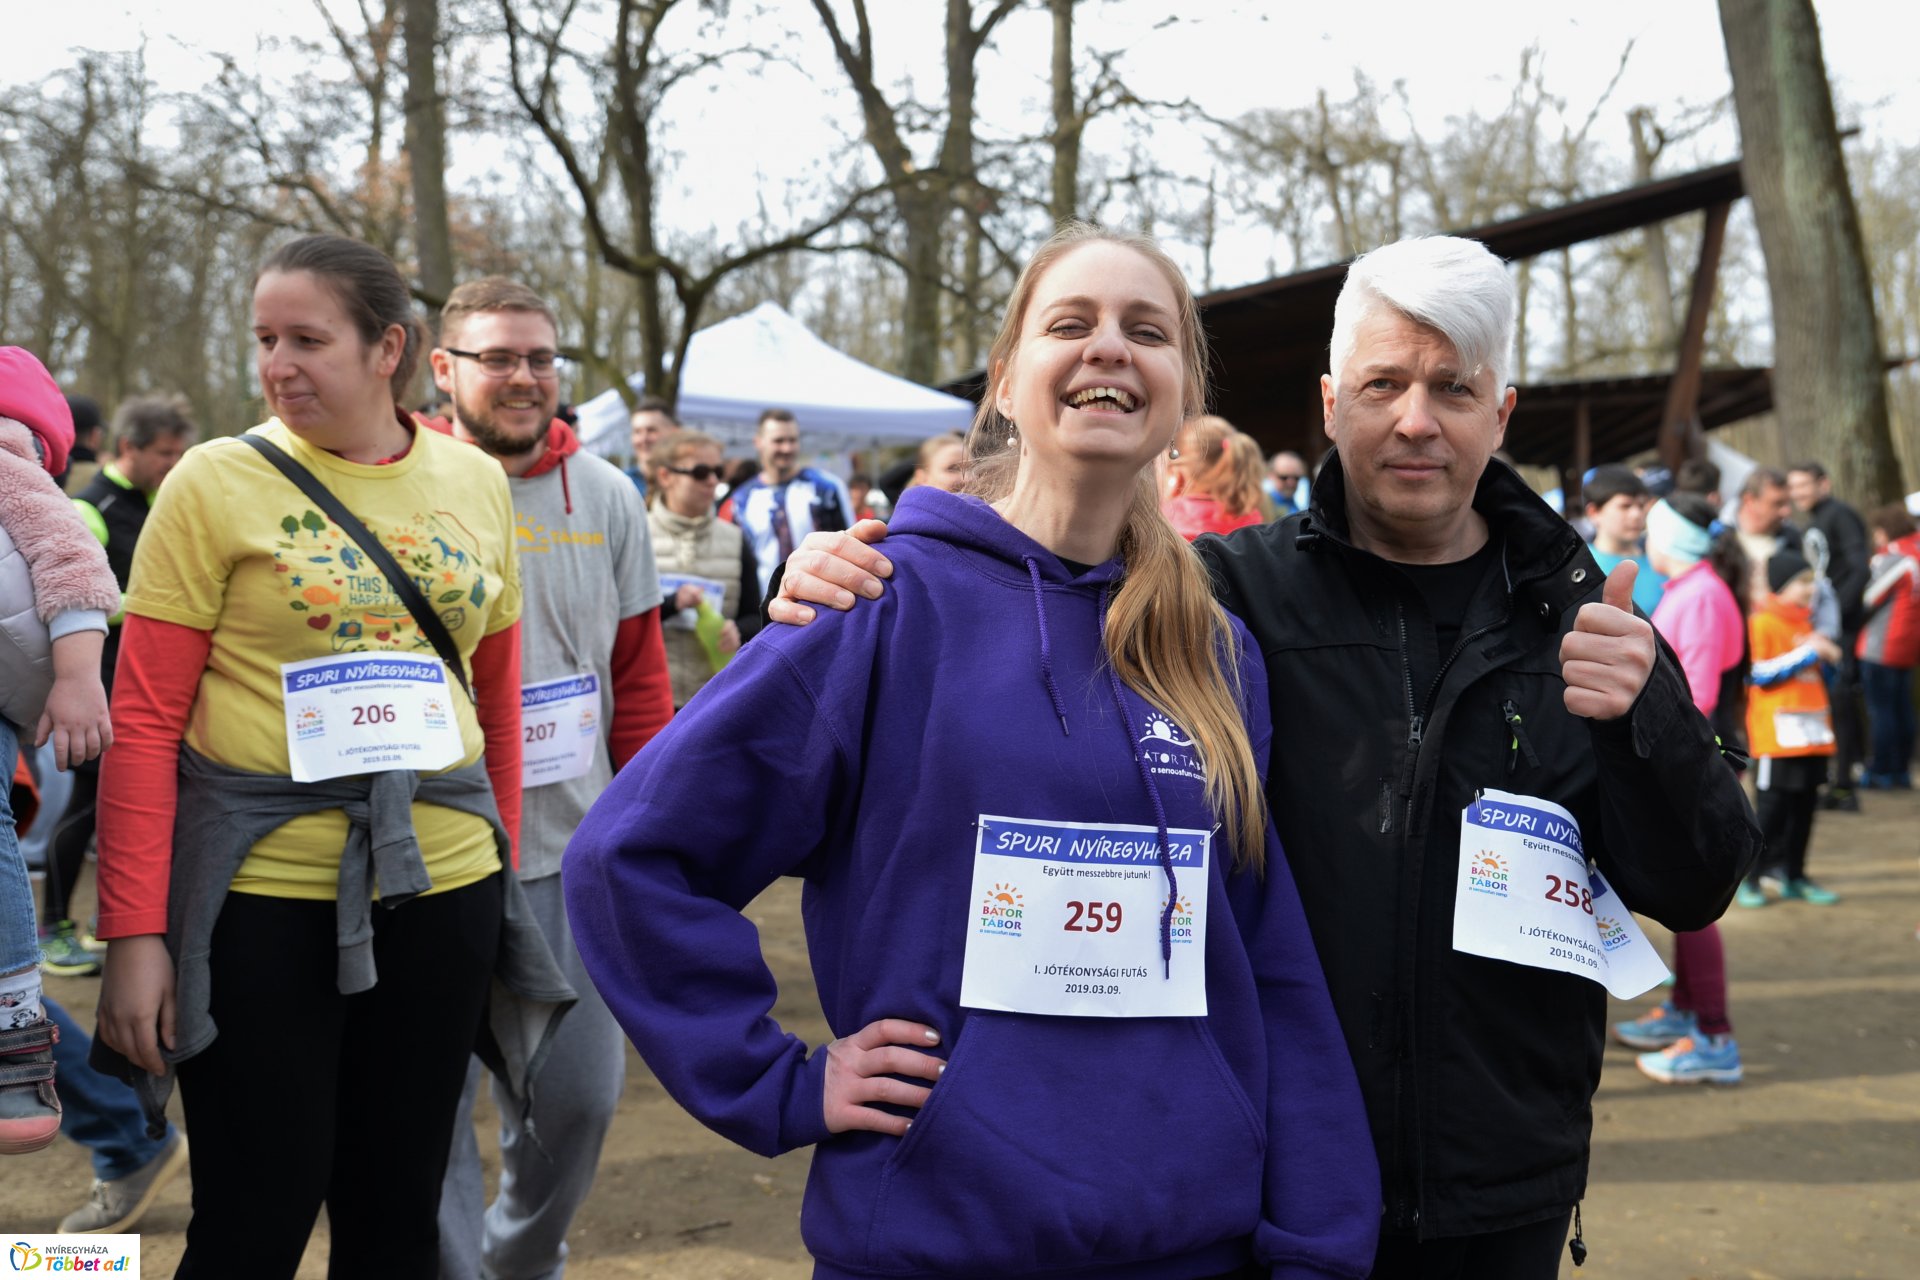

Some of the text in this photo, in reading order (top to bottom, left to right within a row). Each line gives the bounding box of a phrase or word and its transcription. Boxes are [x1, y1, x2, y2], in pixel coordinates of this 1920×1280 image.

[347, 575, 381, 593] THIS
[349, 593, 389, 606] HAPPY
[296, 668, 339, 688] SPURI
[345, 662, 438, 680] NYÍREGYHÁZA
[351, 704, 396, 726] 206
[525, 722, 556, 743] 207
[1135, 749, 1179, 765] ÁTOR
[1481, 808, 1538, 831] SPURI
[996, 831, 1062, 855] SPURI
[1523, 838, 1550, 852] Együtt
[1043, 865, 1151, 880] Együtt messzebbre jutunk!
[1471, 866, 1508, 881] BÁTOR
[1469, 876, 1508, 891] TÁBOR
[1544, 874, 1594, 916] 258
[982, 904, 1023, 918] BÁTOR
[1063, 900, 1123, 933] 259
[981, 916, 1022, 930] TÁBOR
[1159, 928, 1192, 937] BOR
[1519, 926, 1526, 935] I.
[1528, 927, 1596, 954] JÓTÉKONYSÁGI
[1550, 947, 1600, 970] 2019.03.09.
[1034, 964, 1148, 978] I. JÓTÉKONYSÁGI FUTÁS
[1065, 984, 1121, 995] 2019.03.09.
